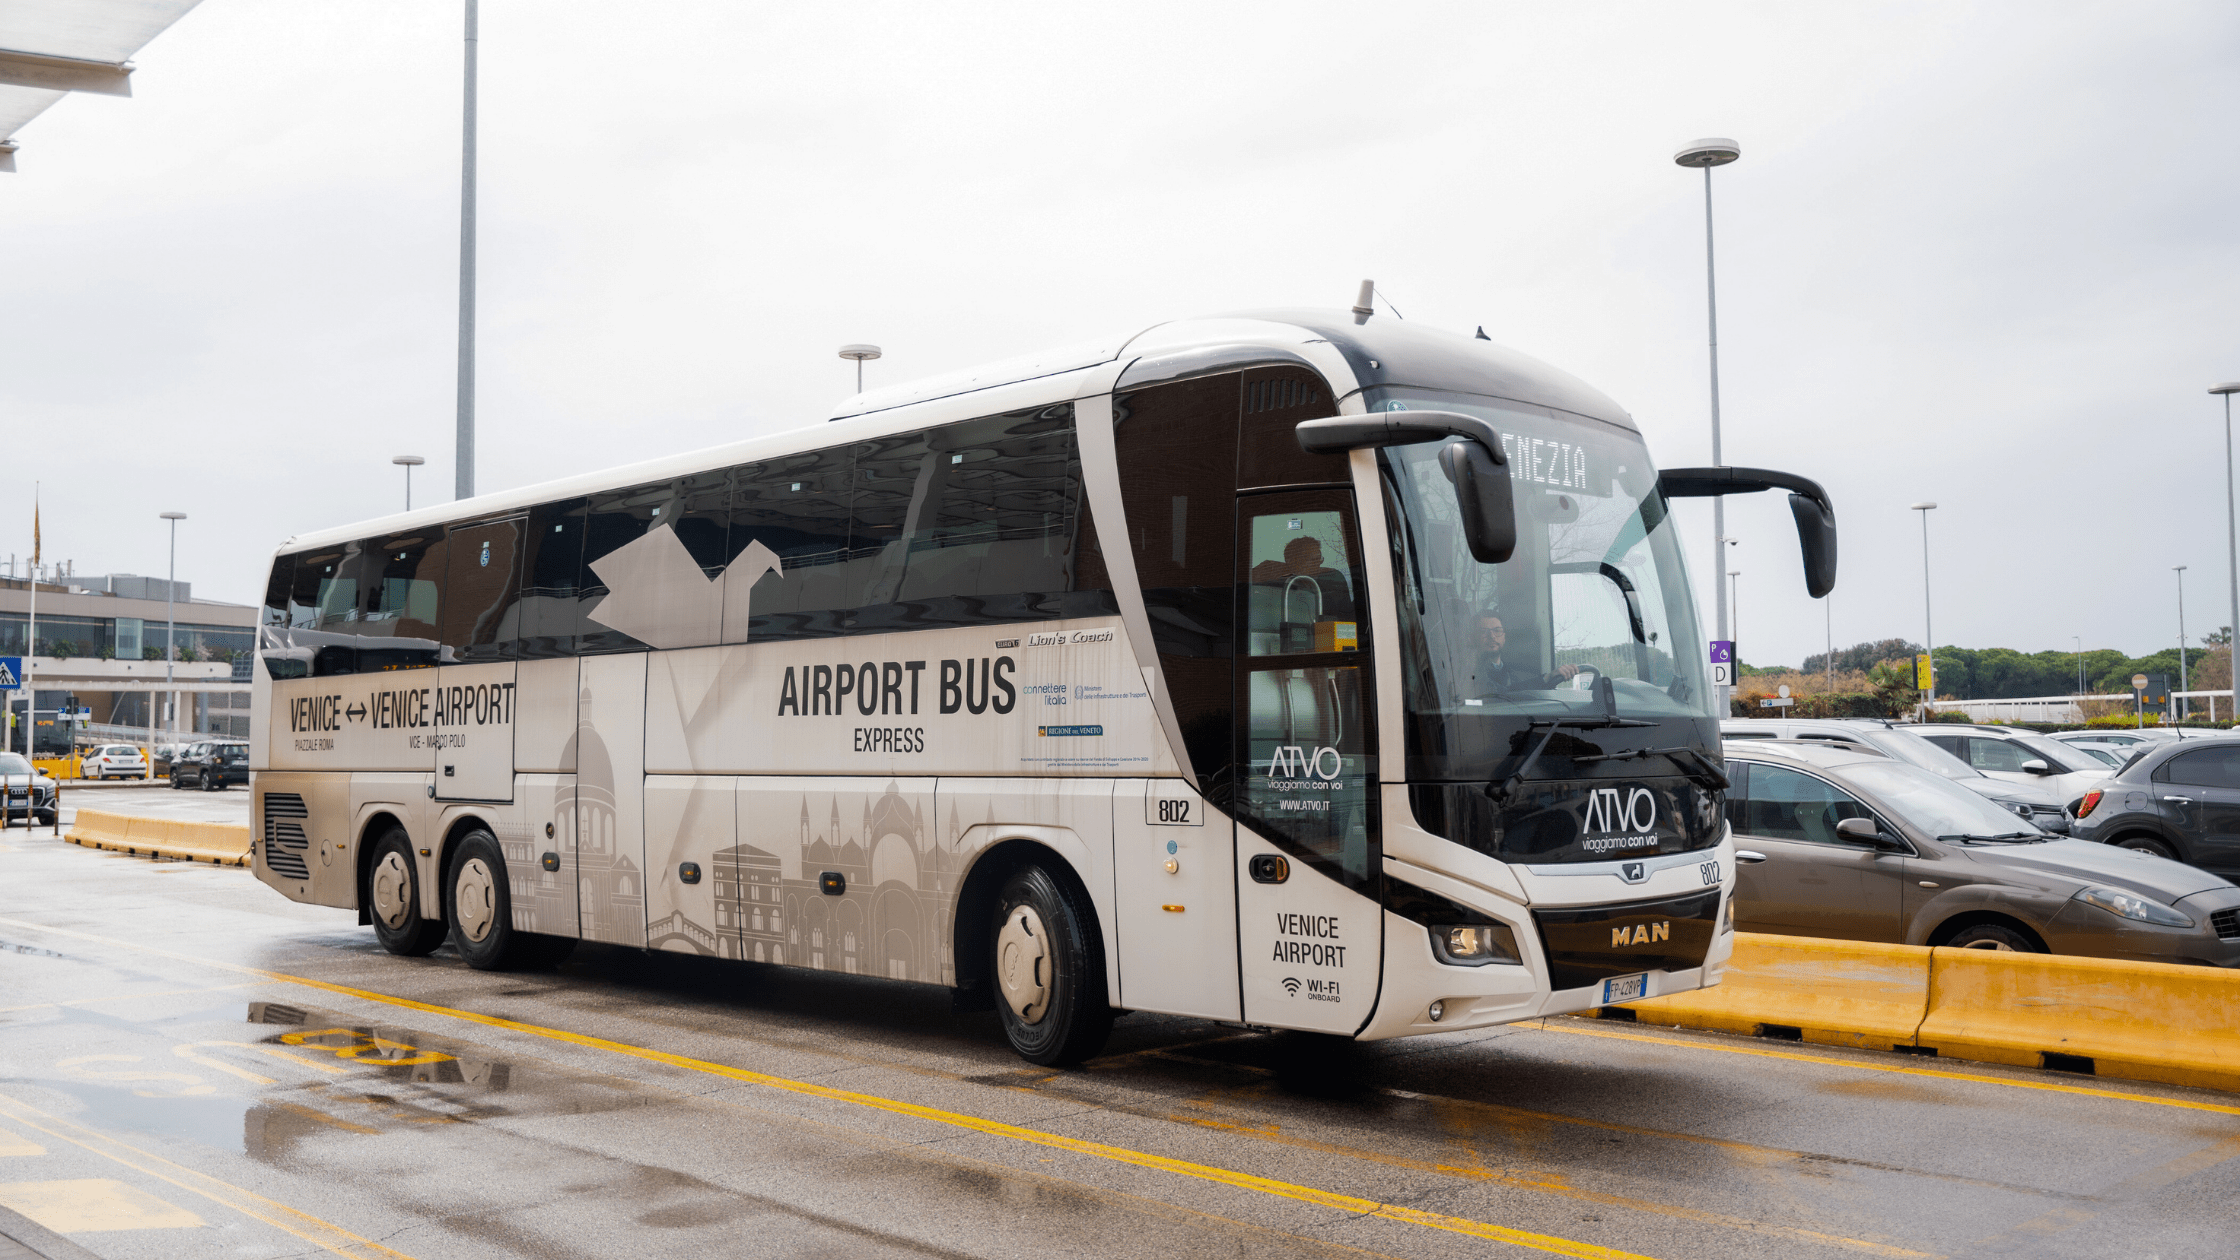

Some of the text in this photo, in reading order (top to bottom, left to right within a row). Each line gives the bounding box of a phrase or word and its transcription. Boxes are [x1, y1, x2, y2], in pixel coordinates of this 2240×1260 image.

[1502, 433, 1586, 489] ENEZIA
[1028, 631, 1113, 647] Lion's Coach
[1711, 643, 1717, 652] P
[1715, 666, 1726, 682] D
[778, 655, 1016, 716] AIRPORT BUS
[1023, 683, 1066, 694] connettere
[290, 682, 514, 732] VENICE VENICE AIRPORT
[854, 727, 924, 753] EXPRESS
[1080, 726, 1101, 734] VENETO
[295, 738, 334, 751] PIAZZALE ROMA
[409, 735, 421, 749] VCE
[426, 734, 447, 748] MARCO
[449, 734, 465, 748] POLO
[1268, 746, 1341, 780] ATVO
[1267, 780, 1343, 791] viaggiamo con voi
[1159, 800, 1189, 822] 802
[1280, 800, 1330, 811] WWW.ATVO.IT
[1583, 788, 1656, 834] ATVO
[1582, 832, 1658, 853] viaggiamo con voi
[1700, 861, 1722, 886] 802
[1277, 912, 1339, 939] VENICE
[1611, 921, 1670, 948] MAN
[1272, 940, 1346, 968] AIRPORT
[1306, 978, 1340, 995] WI-FI
[1307, 993, 1341, 1003] ONBOARD
